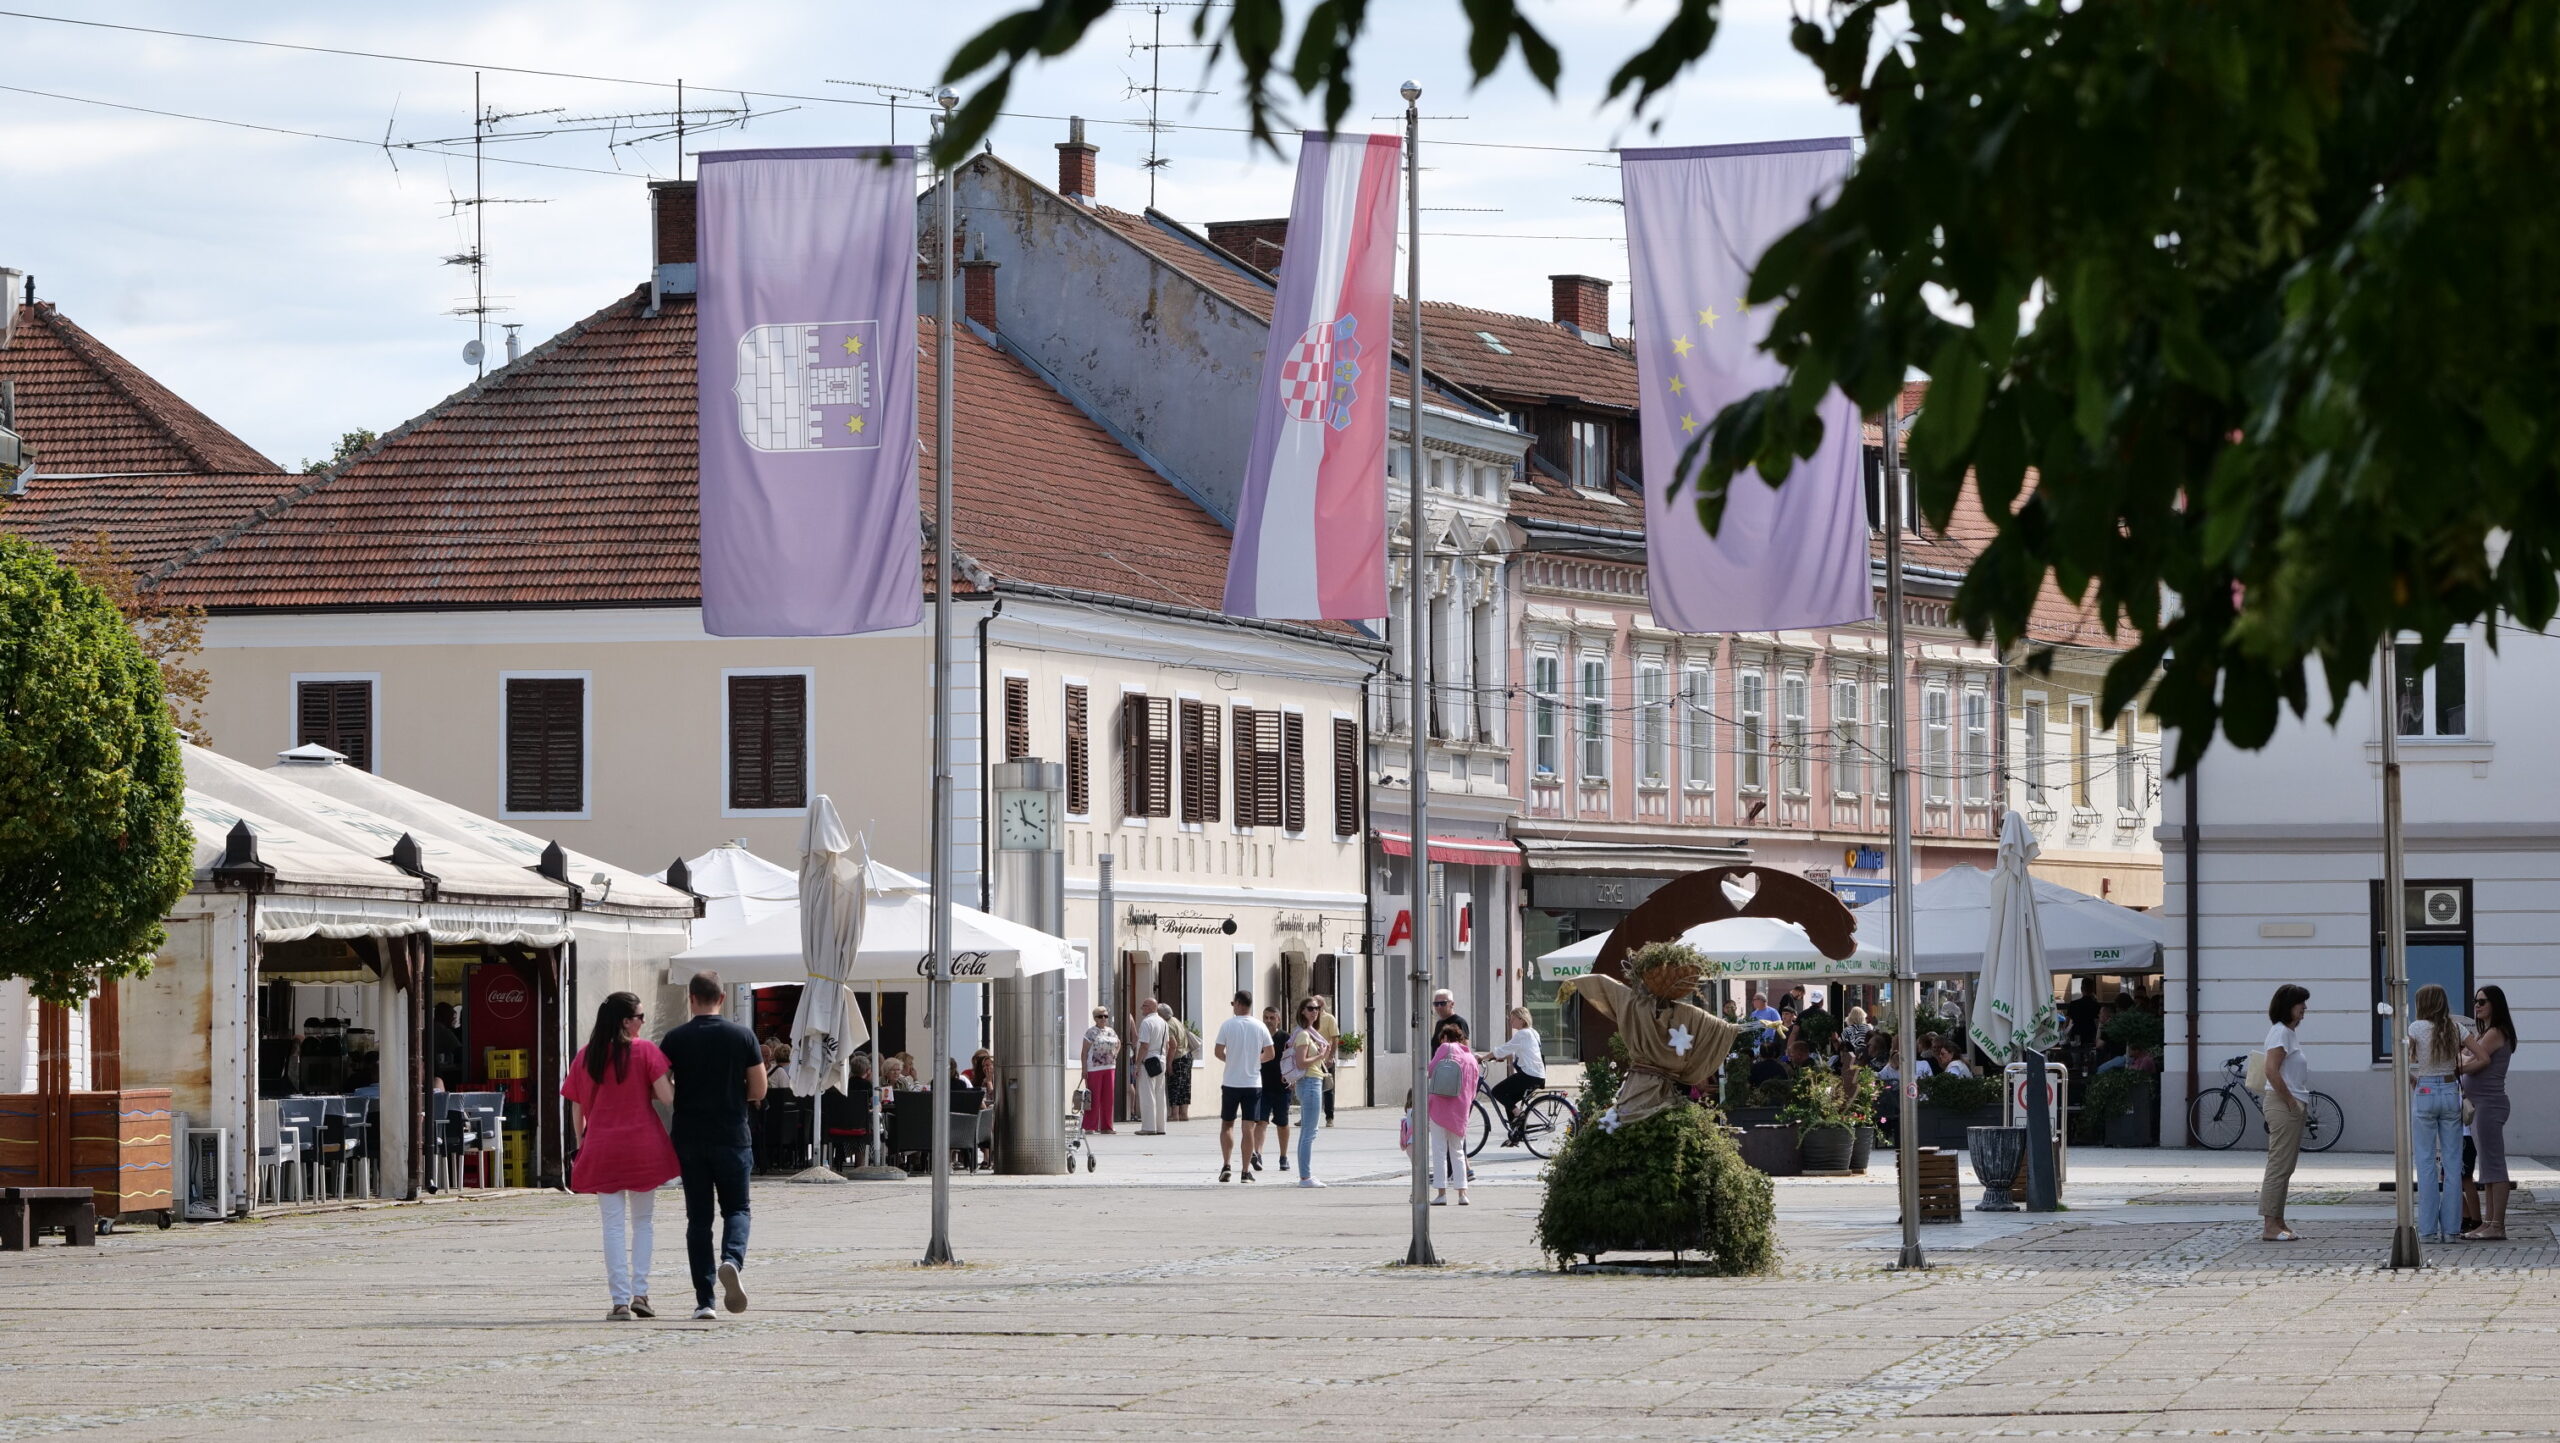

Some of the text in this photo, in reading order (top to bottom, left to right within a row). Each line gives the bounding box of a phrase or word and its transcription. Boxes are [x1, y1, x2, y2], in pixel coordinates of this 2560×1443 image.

[2094, 950, 2120, 959] PAN
[1750, 961, 1816, 971] TO TE JA PITAM!
[1552, 966, 1582, 977] PAN
